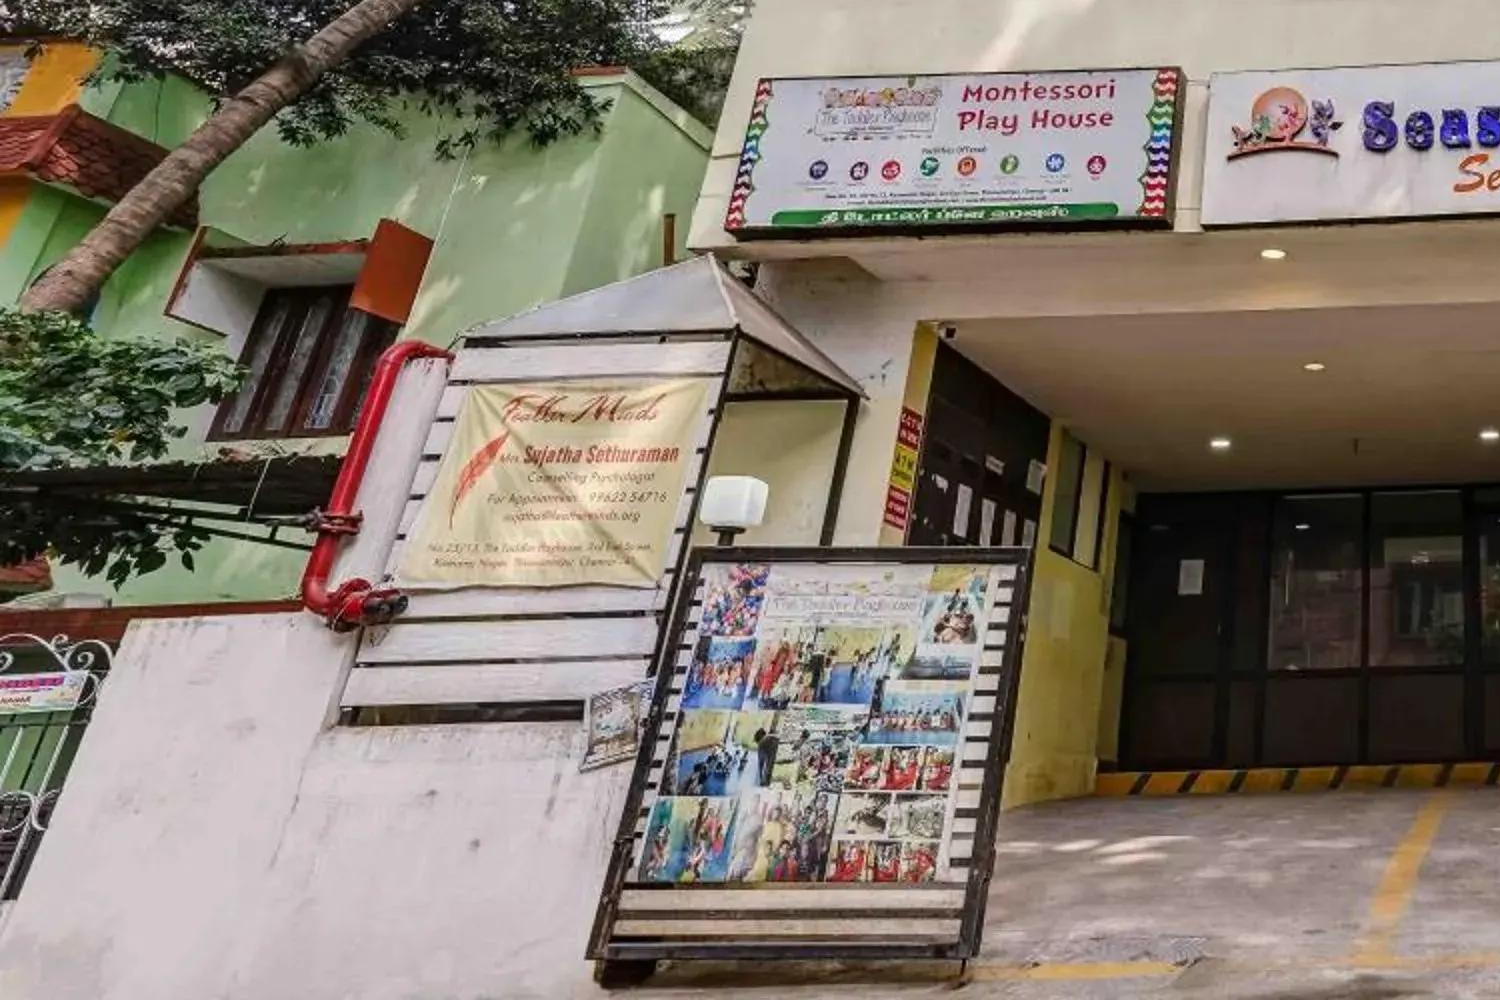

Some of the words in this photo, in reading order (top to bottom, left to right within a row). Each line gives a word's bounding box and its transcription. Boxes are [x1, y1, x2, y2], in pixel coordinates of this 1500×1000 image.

[961, 79, 1116, 103] Montessori
[957, 110, 1018, 136] Play
[1031, 110, 1113, 129] House
[570, 393, 667, 423] Minds
[524, 444, 583, 468] Sujatha
[586, 445, 679, 465] Sethuraman
